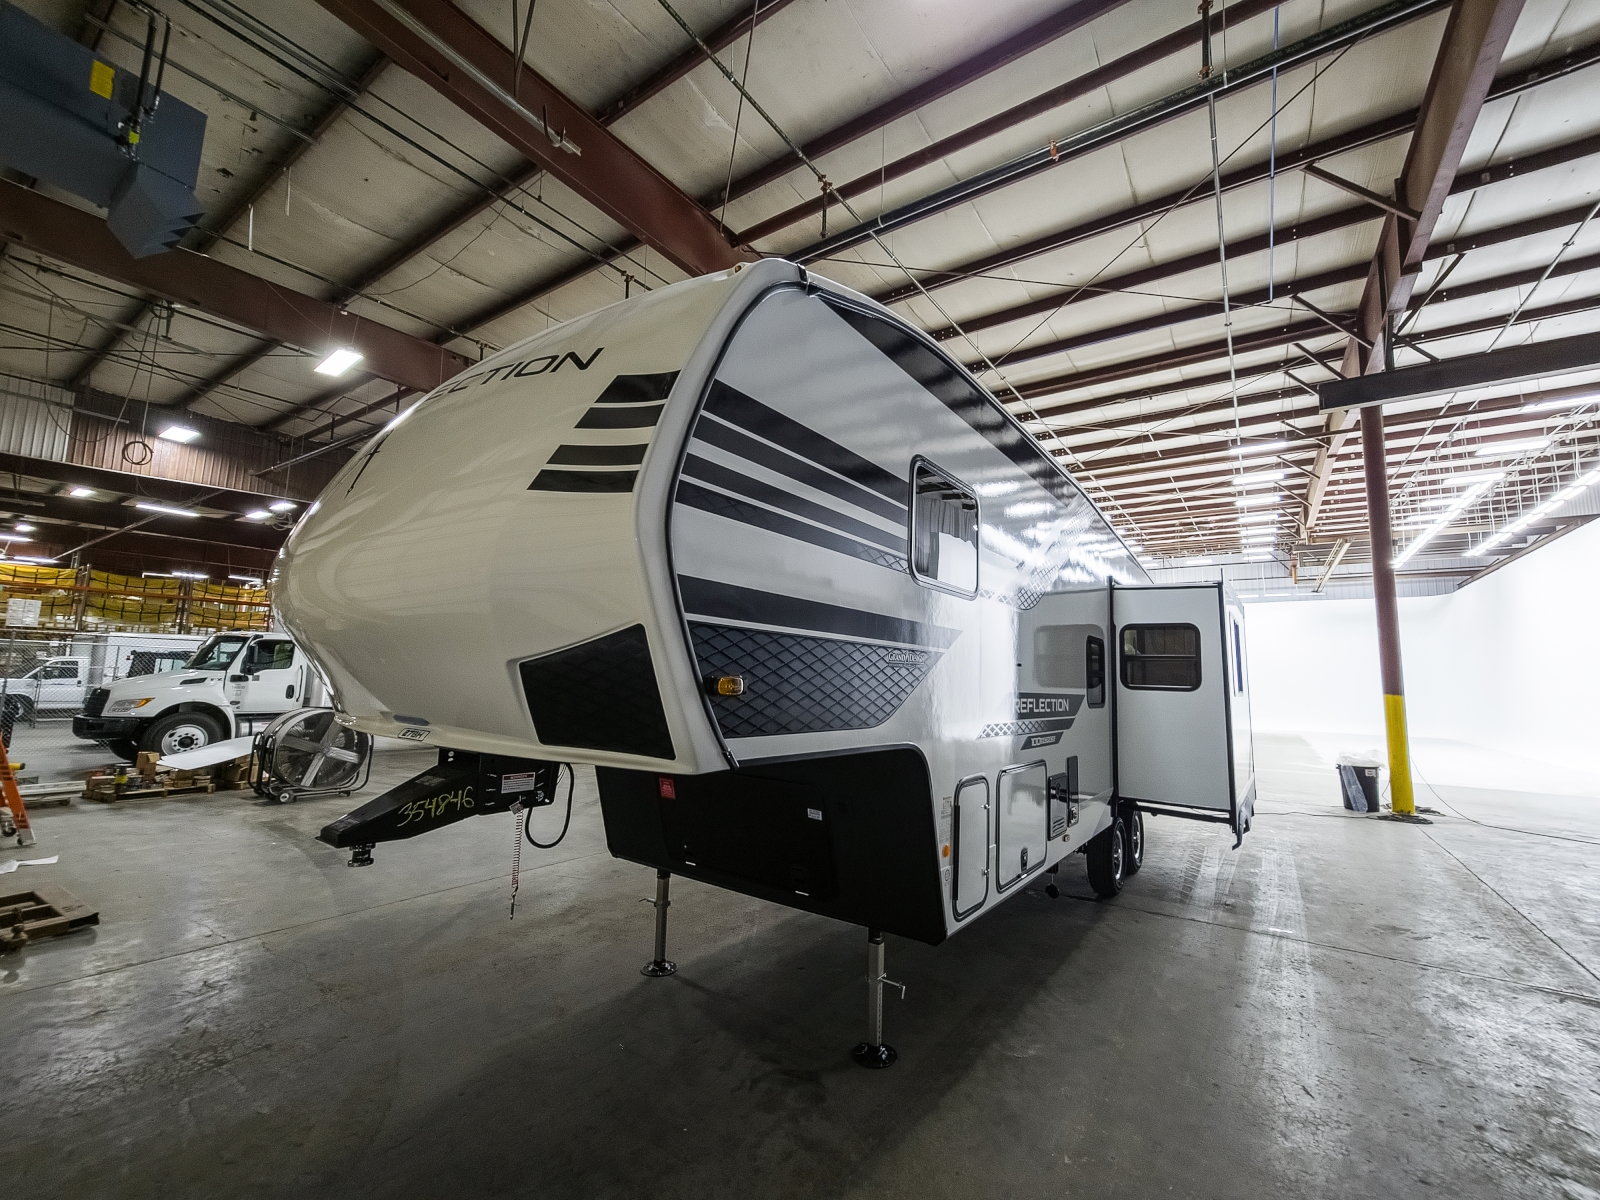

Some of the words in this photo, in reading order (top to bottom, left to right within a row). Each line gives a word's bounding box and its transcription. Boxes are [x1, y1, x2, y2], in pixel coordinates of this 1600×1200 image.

[1014, 698, 1069, 713] REFLECTION
[1031, 737, 1041, 746] 100
[397, 786, 475, 827] 354846
